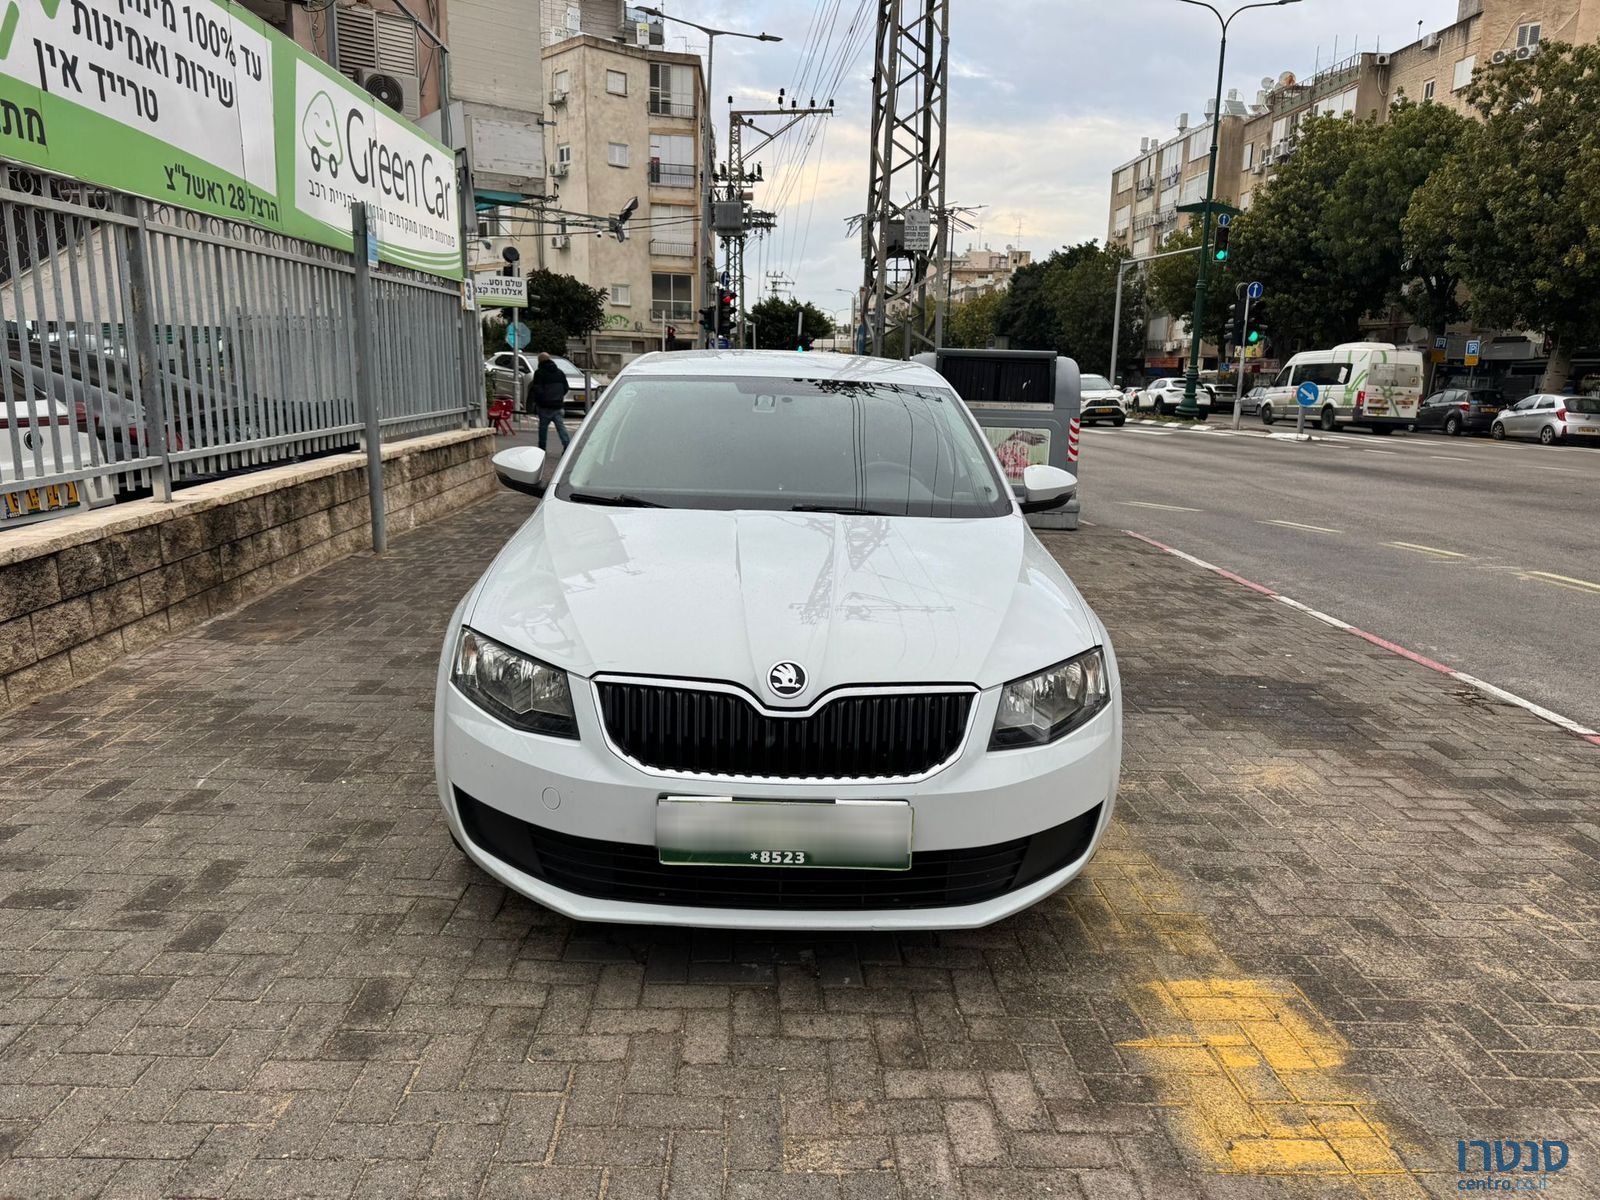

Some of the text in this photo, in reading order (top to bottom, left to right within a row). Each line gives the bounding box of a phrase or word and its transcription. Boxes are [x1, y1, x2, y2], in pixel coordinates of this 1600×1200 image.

[182, 6, 237, 67] 100%
[71, 0, 234, 108] שירות ואמינות
[240, 44, 262, 81] עד
[33, 38, 158, 122] טרייד אין
[0, 98, 47, 146] מת
[346, 108, 450, 221] Green Car
[227, 183, 246, 212] 28
[248, 188, 279, 222] הרצל
[308, 179, 327, 201] רכב
[329, 187, 358, 214] קניית
[490, 287, 500, 295] זה
[501, 287, 523, 296] אצלנו
[504, 279, 523, 288] שלם
